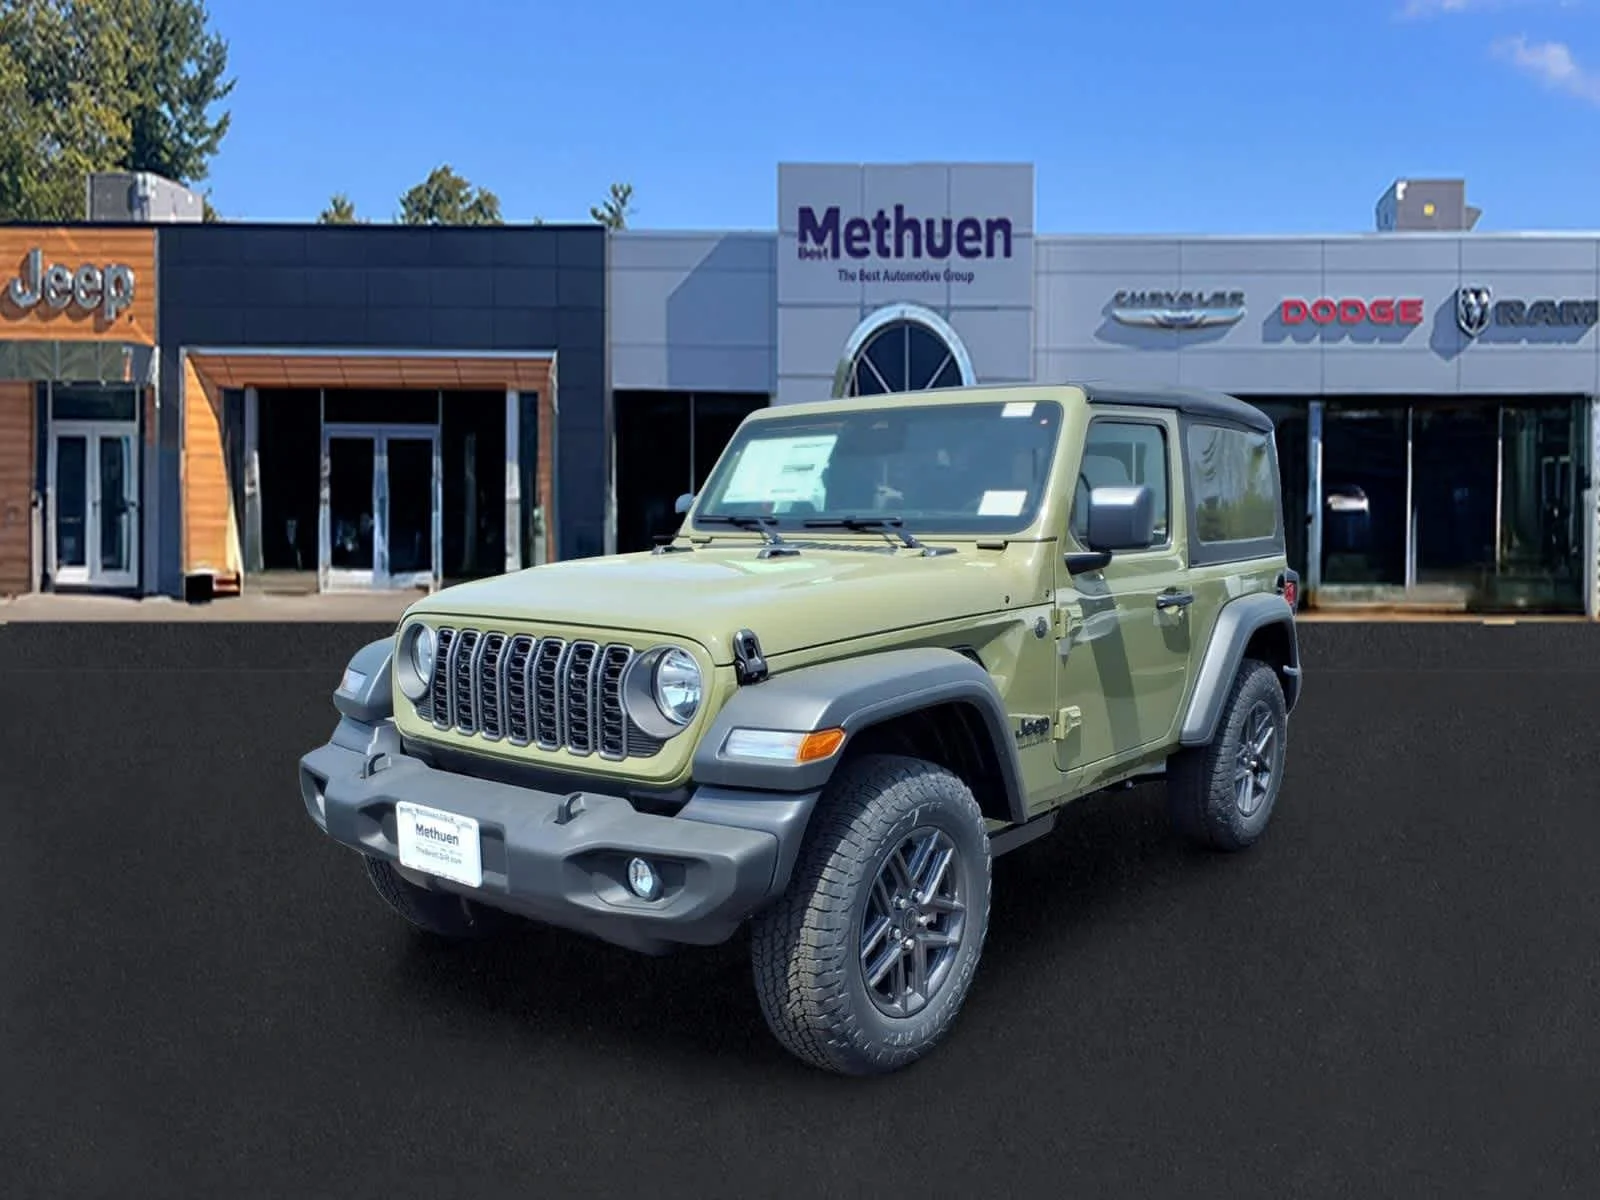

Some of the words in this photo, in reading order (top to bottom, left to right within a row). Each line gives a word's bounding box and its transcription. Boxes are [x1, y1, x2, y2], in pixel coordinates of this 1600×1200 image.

[798, 204, 1012, 259] Methuen
[9, 248, 135, 320] Jeep
[838, 269, 856, 282] The
[859, 269, 880, 282] Best
[883, 269, 941, 282] Automotive
[943, 269, 974, 284] Group
[1282, 299, 1424, 325] DODGE
[1495, 300, 1598, 326] RAM
[415, 823, 459, 845] Methuen
